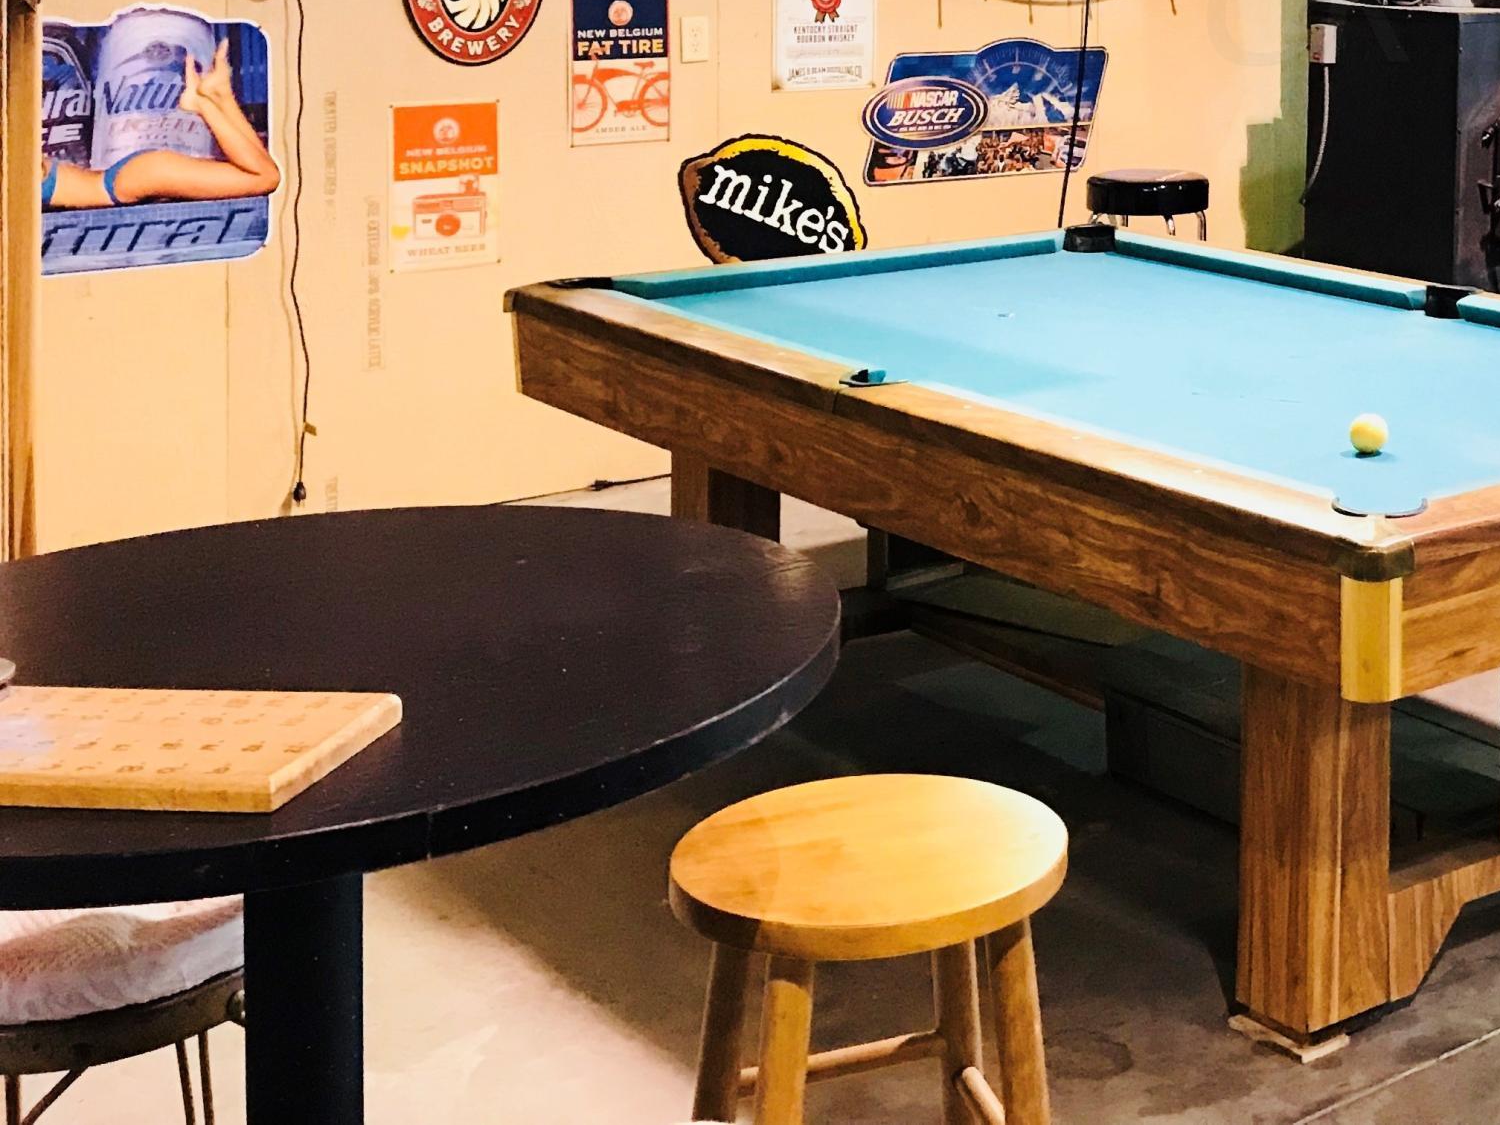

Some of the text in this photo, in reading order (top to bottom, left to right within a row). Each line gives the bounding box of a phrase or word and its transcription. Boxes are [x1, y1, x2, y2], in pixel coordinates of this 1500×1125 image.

[427, 15, 520, 56] BREWERY
[577, 27, 663, 39] NEW BELGIUM
[794, 24, 858, 34] KENTUCKY STRAIGHT
[577, 38, 664, 57] FAT TIRE
[797, 35, 826, 43] BOURBON
[910, 89, 959, 108] NASCAR
[886, 108, 966, 127] BUSCH
[400, 155, 494, 175] SNAPSHOT
[699, 165, 849, 253] mike's
[407, 246, 450, 258] WHEAT
